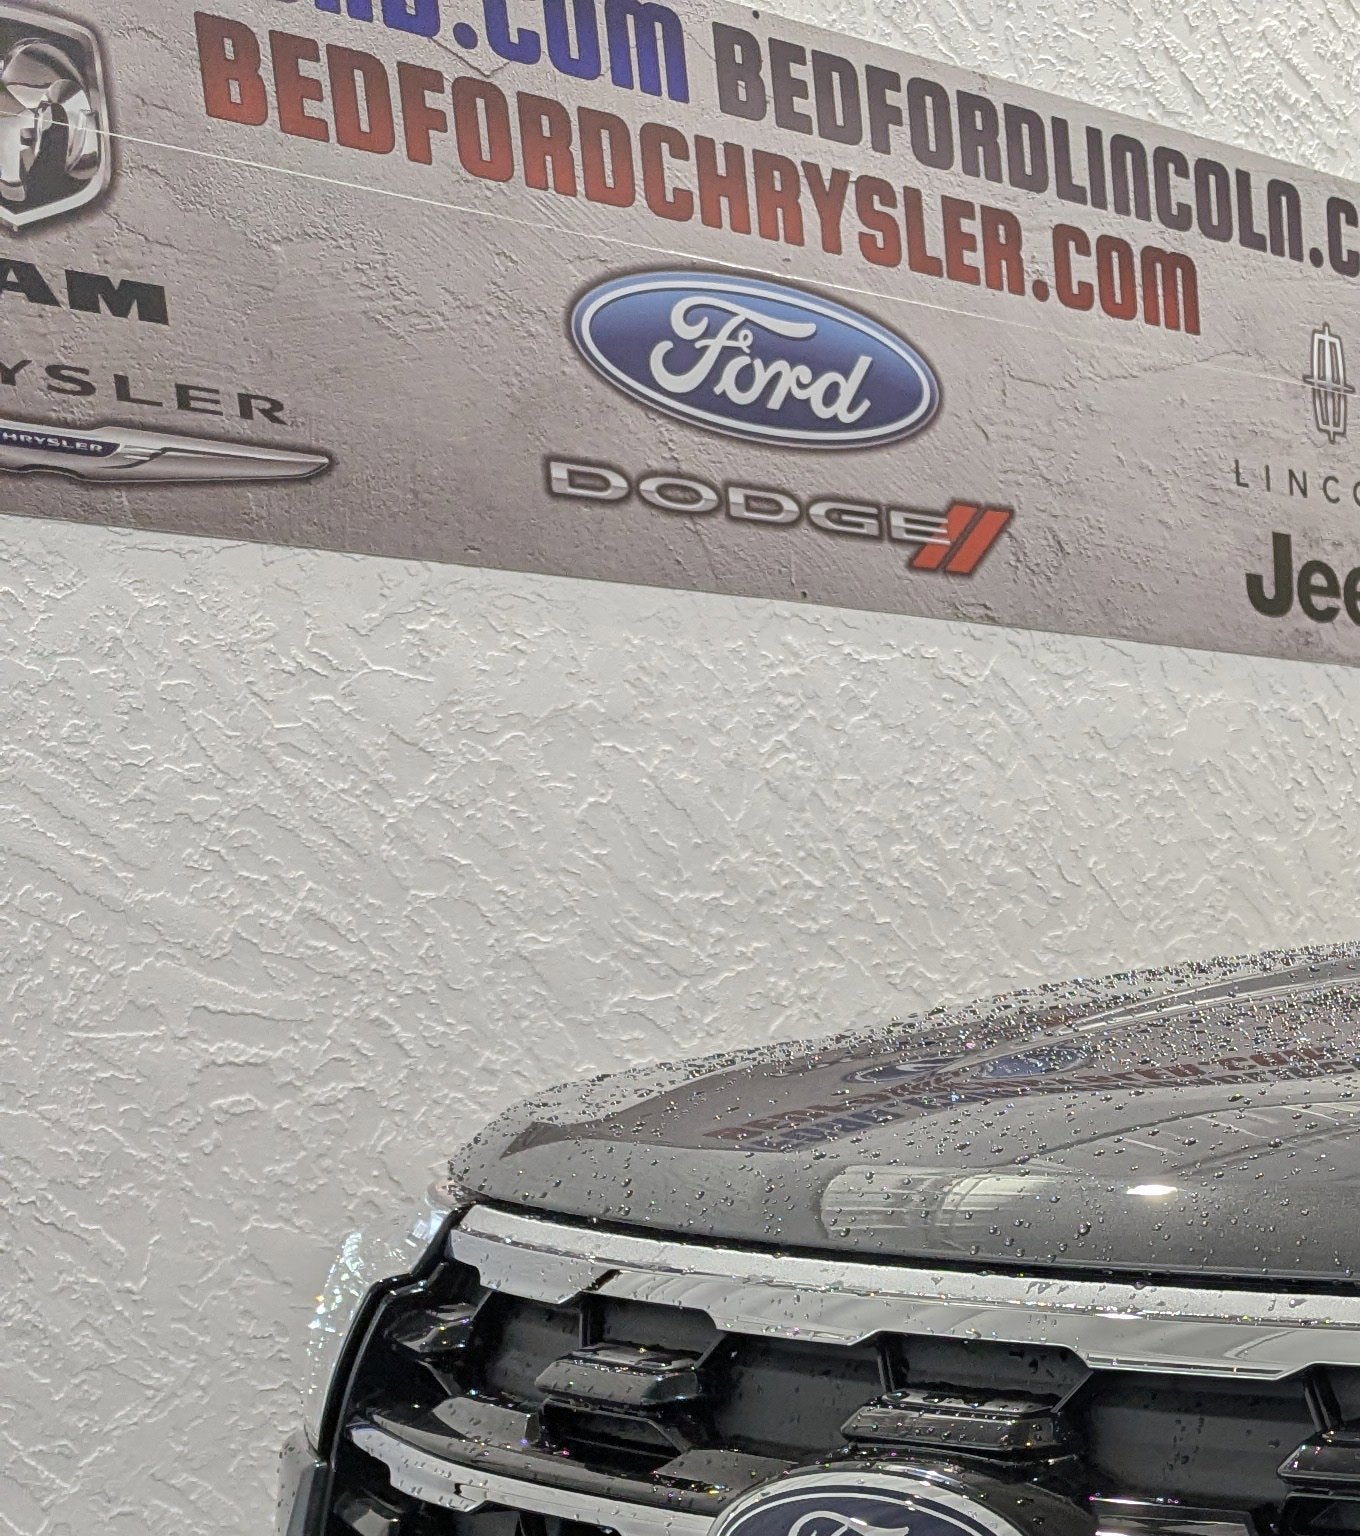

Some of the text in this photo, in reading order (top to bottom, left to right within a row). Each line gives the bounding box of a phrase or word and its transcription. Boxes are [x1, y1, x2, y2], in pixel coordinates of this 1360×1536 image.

[195, 11, 1201, 335] BEDFORDCHRYSLER.COM
[649, 295, 872, 424] Ford
[549, 461, 952, 545] DODGE
